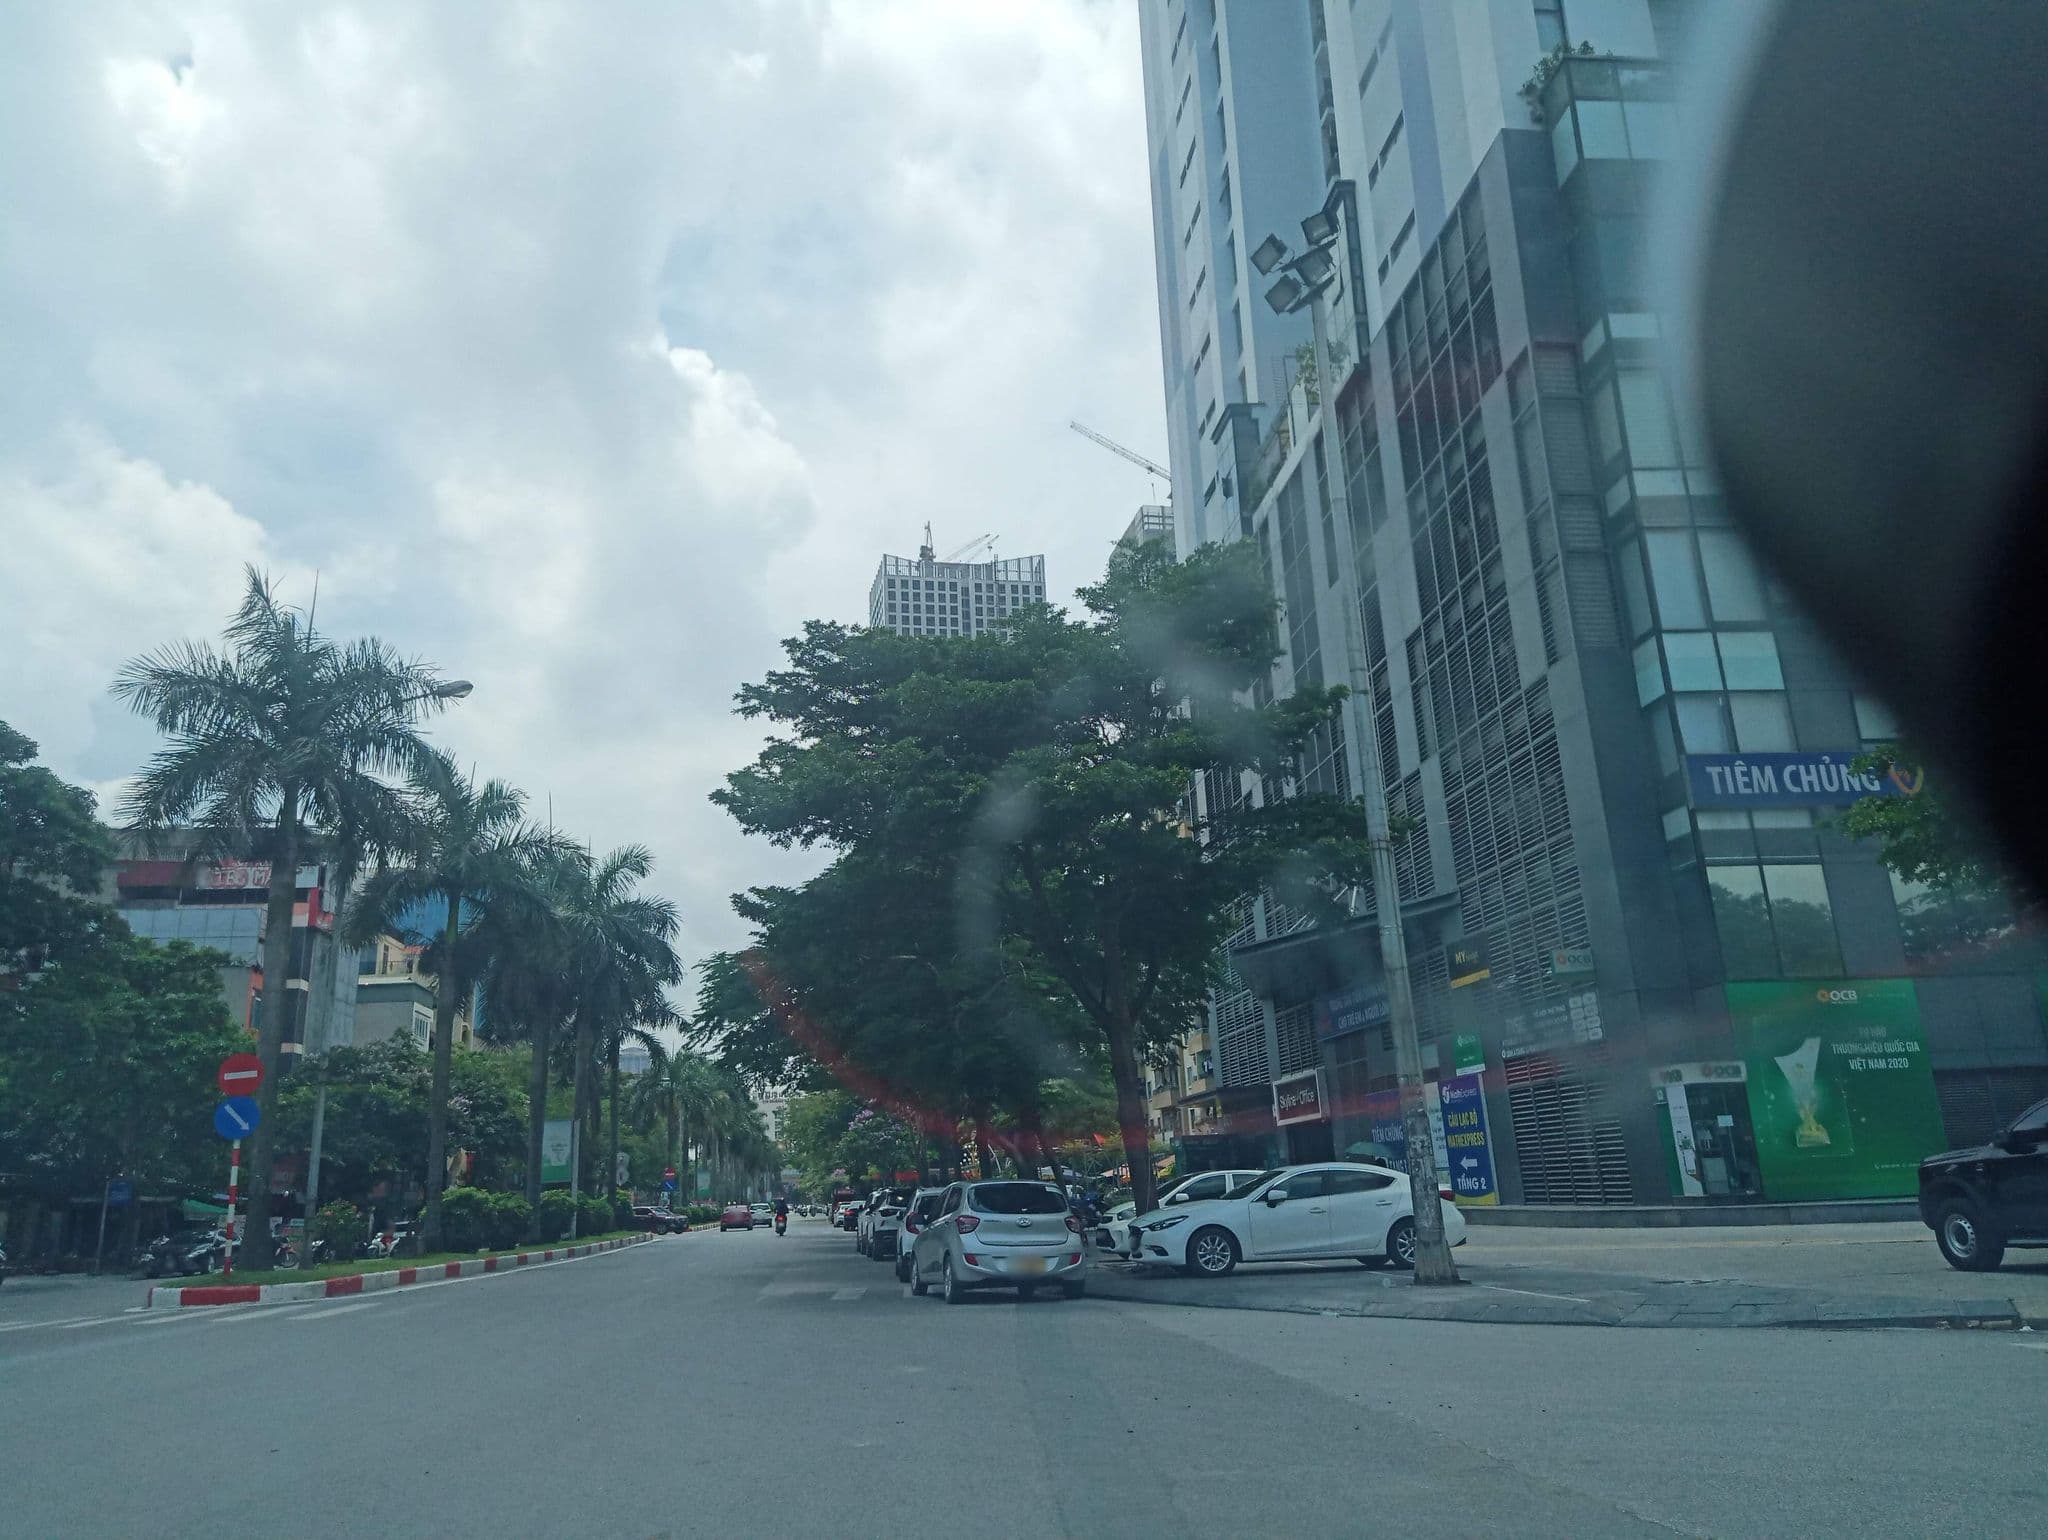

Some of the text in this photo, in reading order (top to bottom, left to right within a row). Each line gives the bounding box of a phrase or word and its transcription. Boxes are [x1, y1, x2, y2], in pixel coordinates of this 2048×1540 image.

[1705, 755, 1881, 795] TIÊM CHỦNG
[1830, 990, 1857, 1001] OCB
[1884, 1038, 1906, 1053] QUỐC
[1906, 1040, 1920, 1052] GIA
[1848, 1057, 1909, 1071] VIỆT NAM 2020
[1457, 1172, 1487, 1191] TẦNG 2
